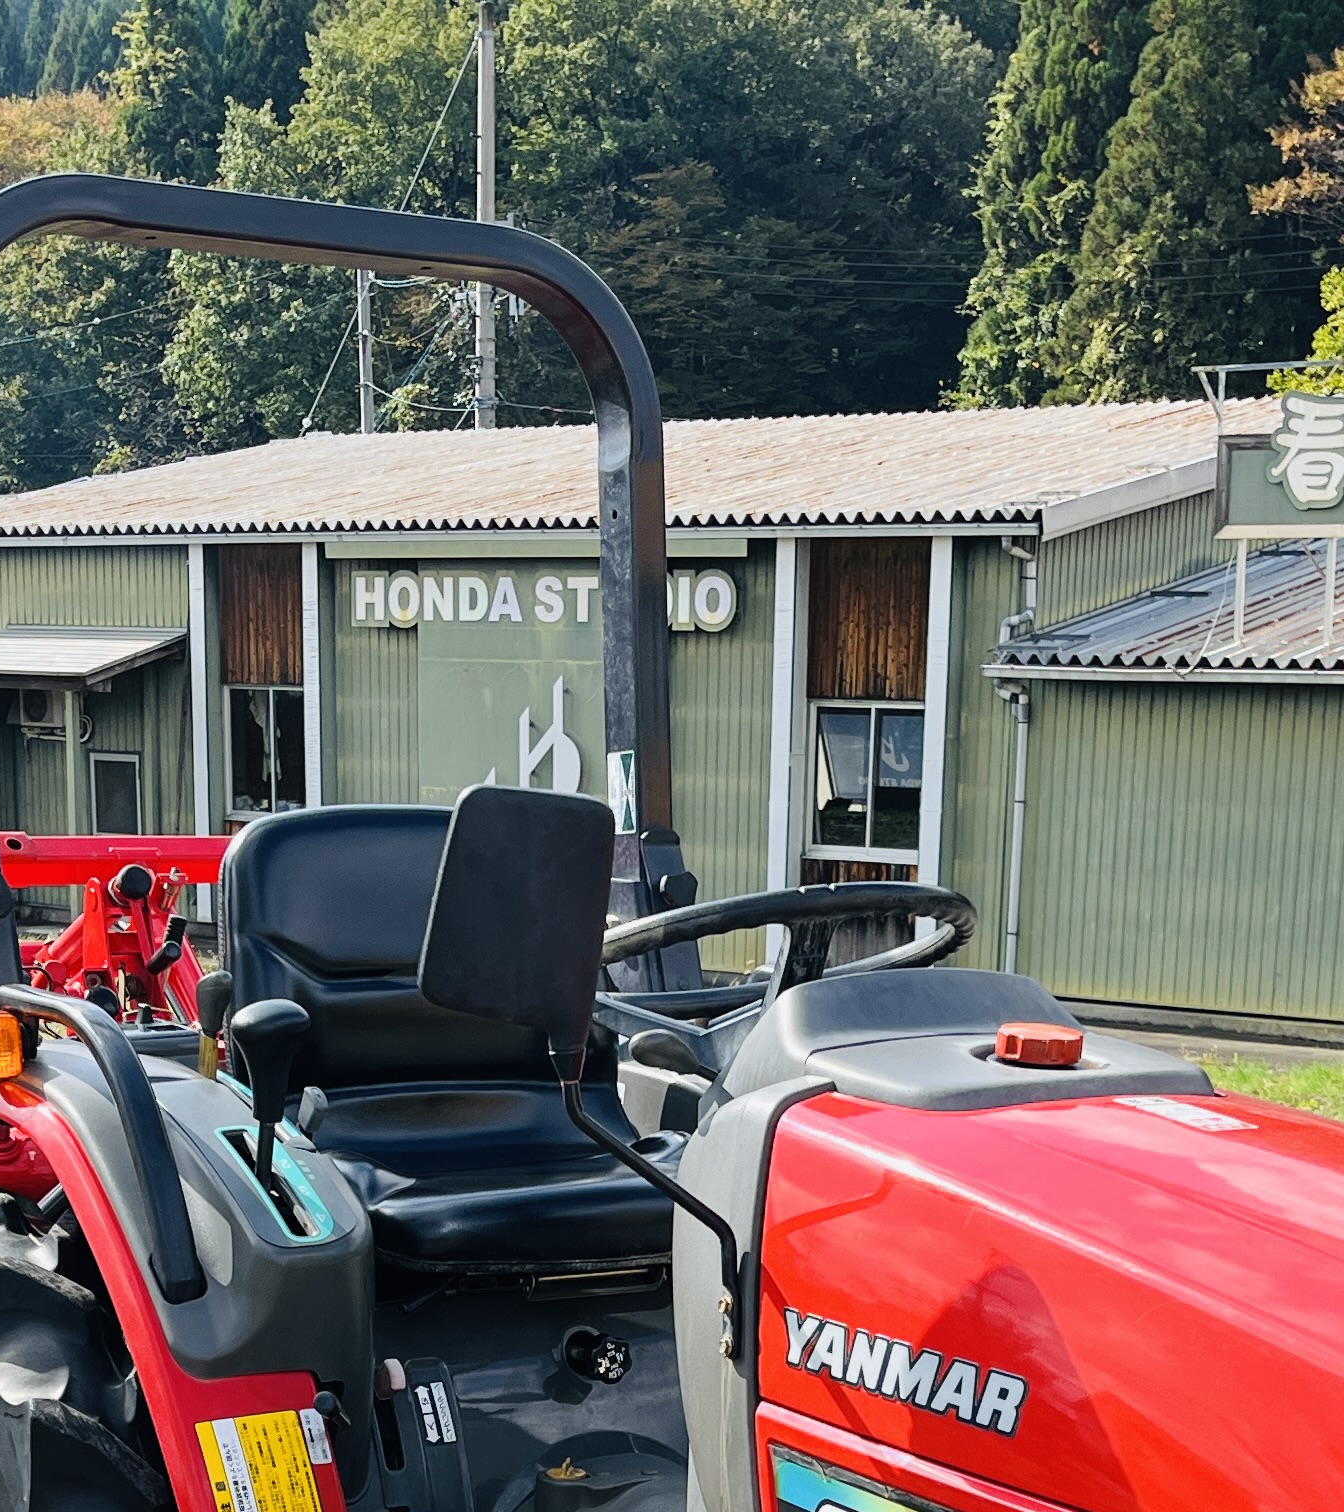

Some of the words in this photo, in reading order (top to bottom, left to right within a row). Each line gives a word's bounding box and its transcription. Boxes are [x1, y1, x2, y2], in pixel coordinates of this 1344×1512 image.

[353, 574, 523, 624] HONDA
[533, 575, 735, 627] STIO
[784, 1306, 1028, 1437] YANMAR
